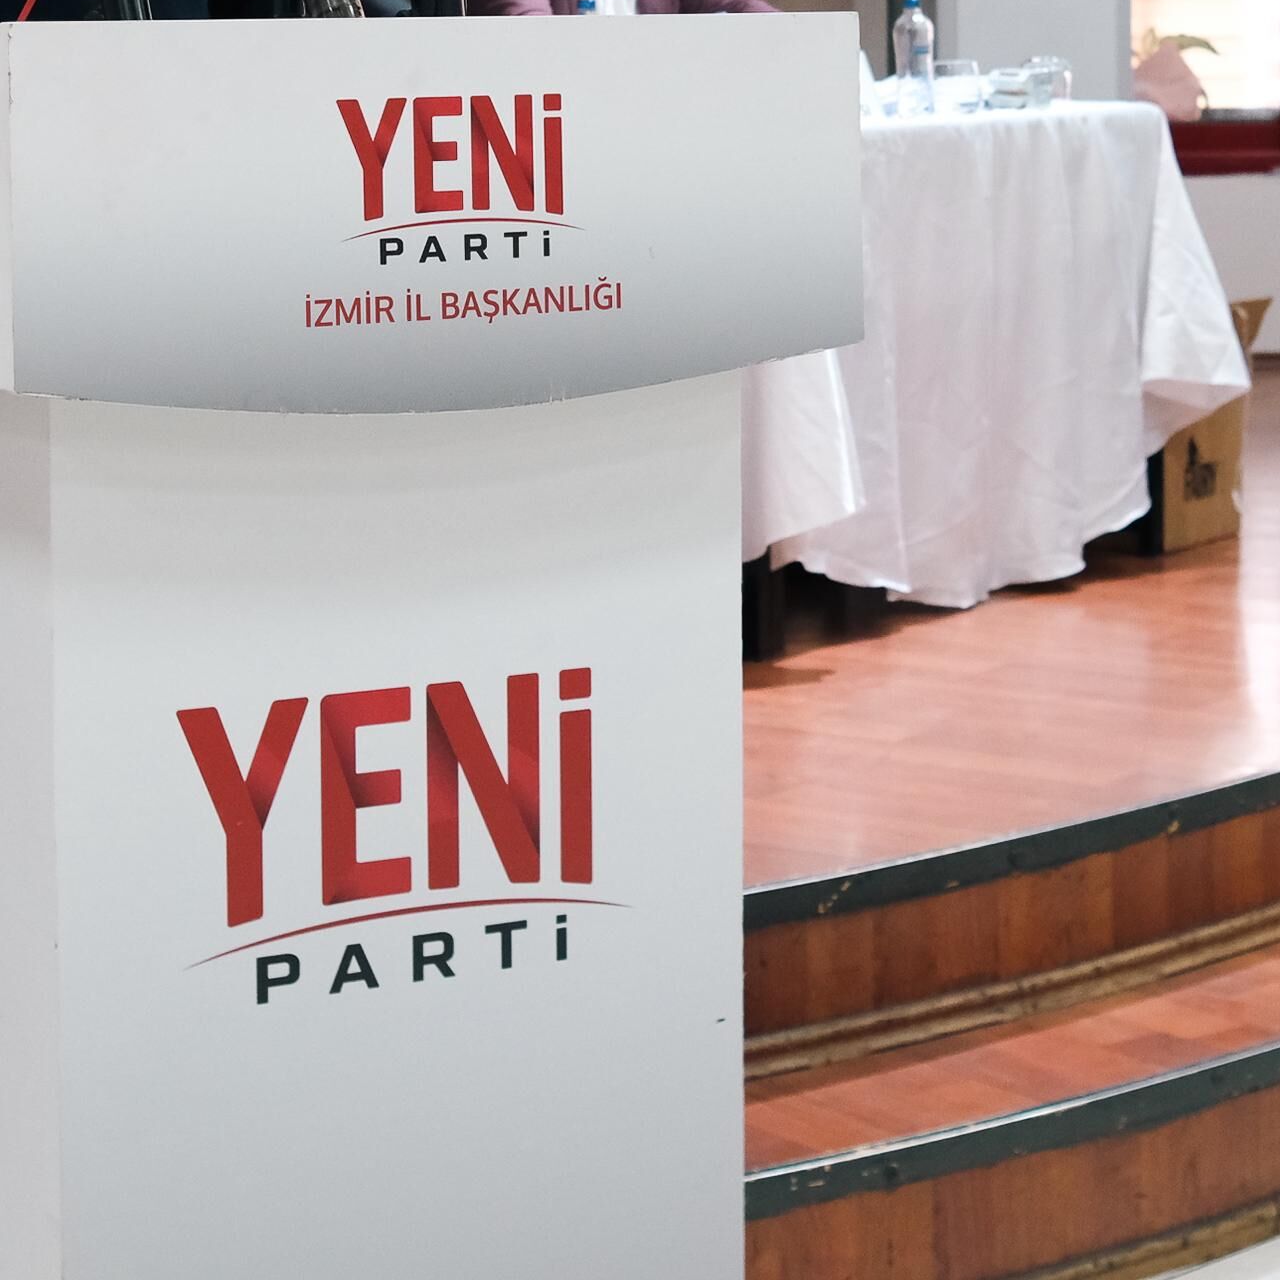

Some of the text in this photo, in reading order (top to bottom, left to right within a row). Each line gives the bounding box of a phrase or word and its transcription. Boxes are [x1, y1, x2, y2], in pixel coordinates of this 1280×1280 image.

[305, 276, 623, 328] İZMİR İL BAŞKANLIĞI
